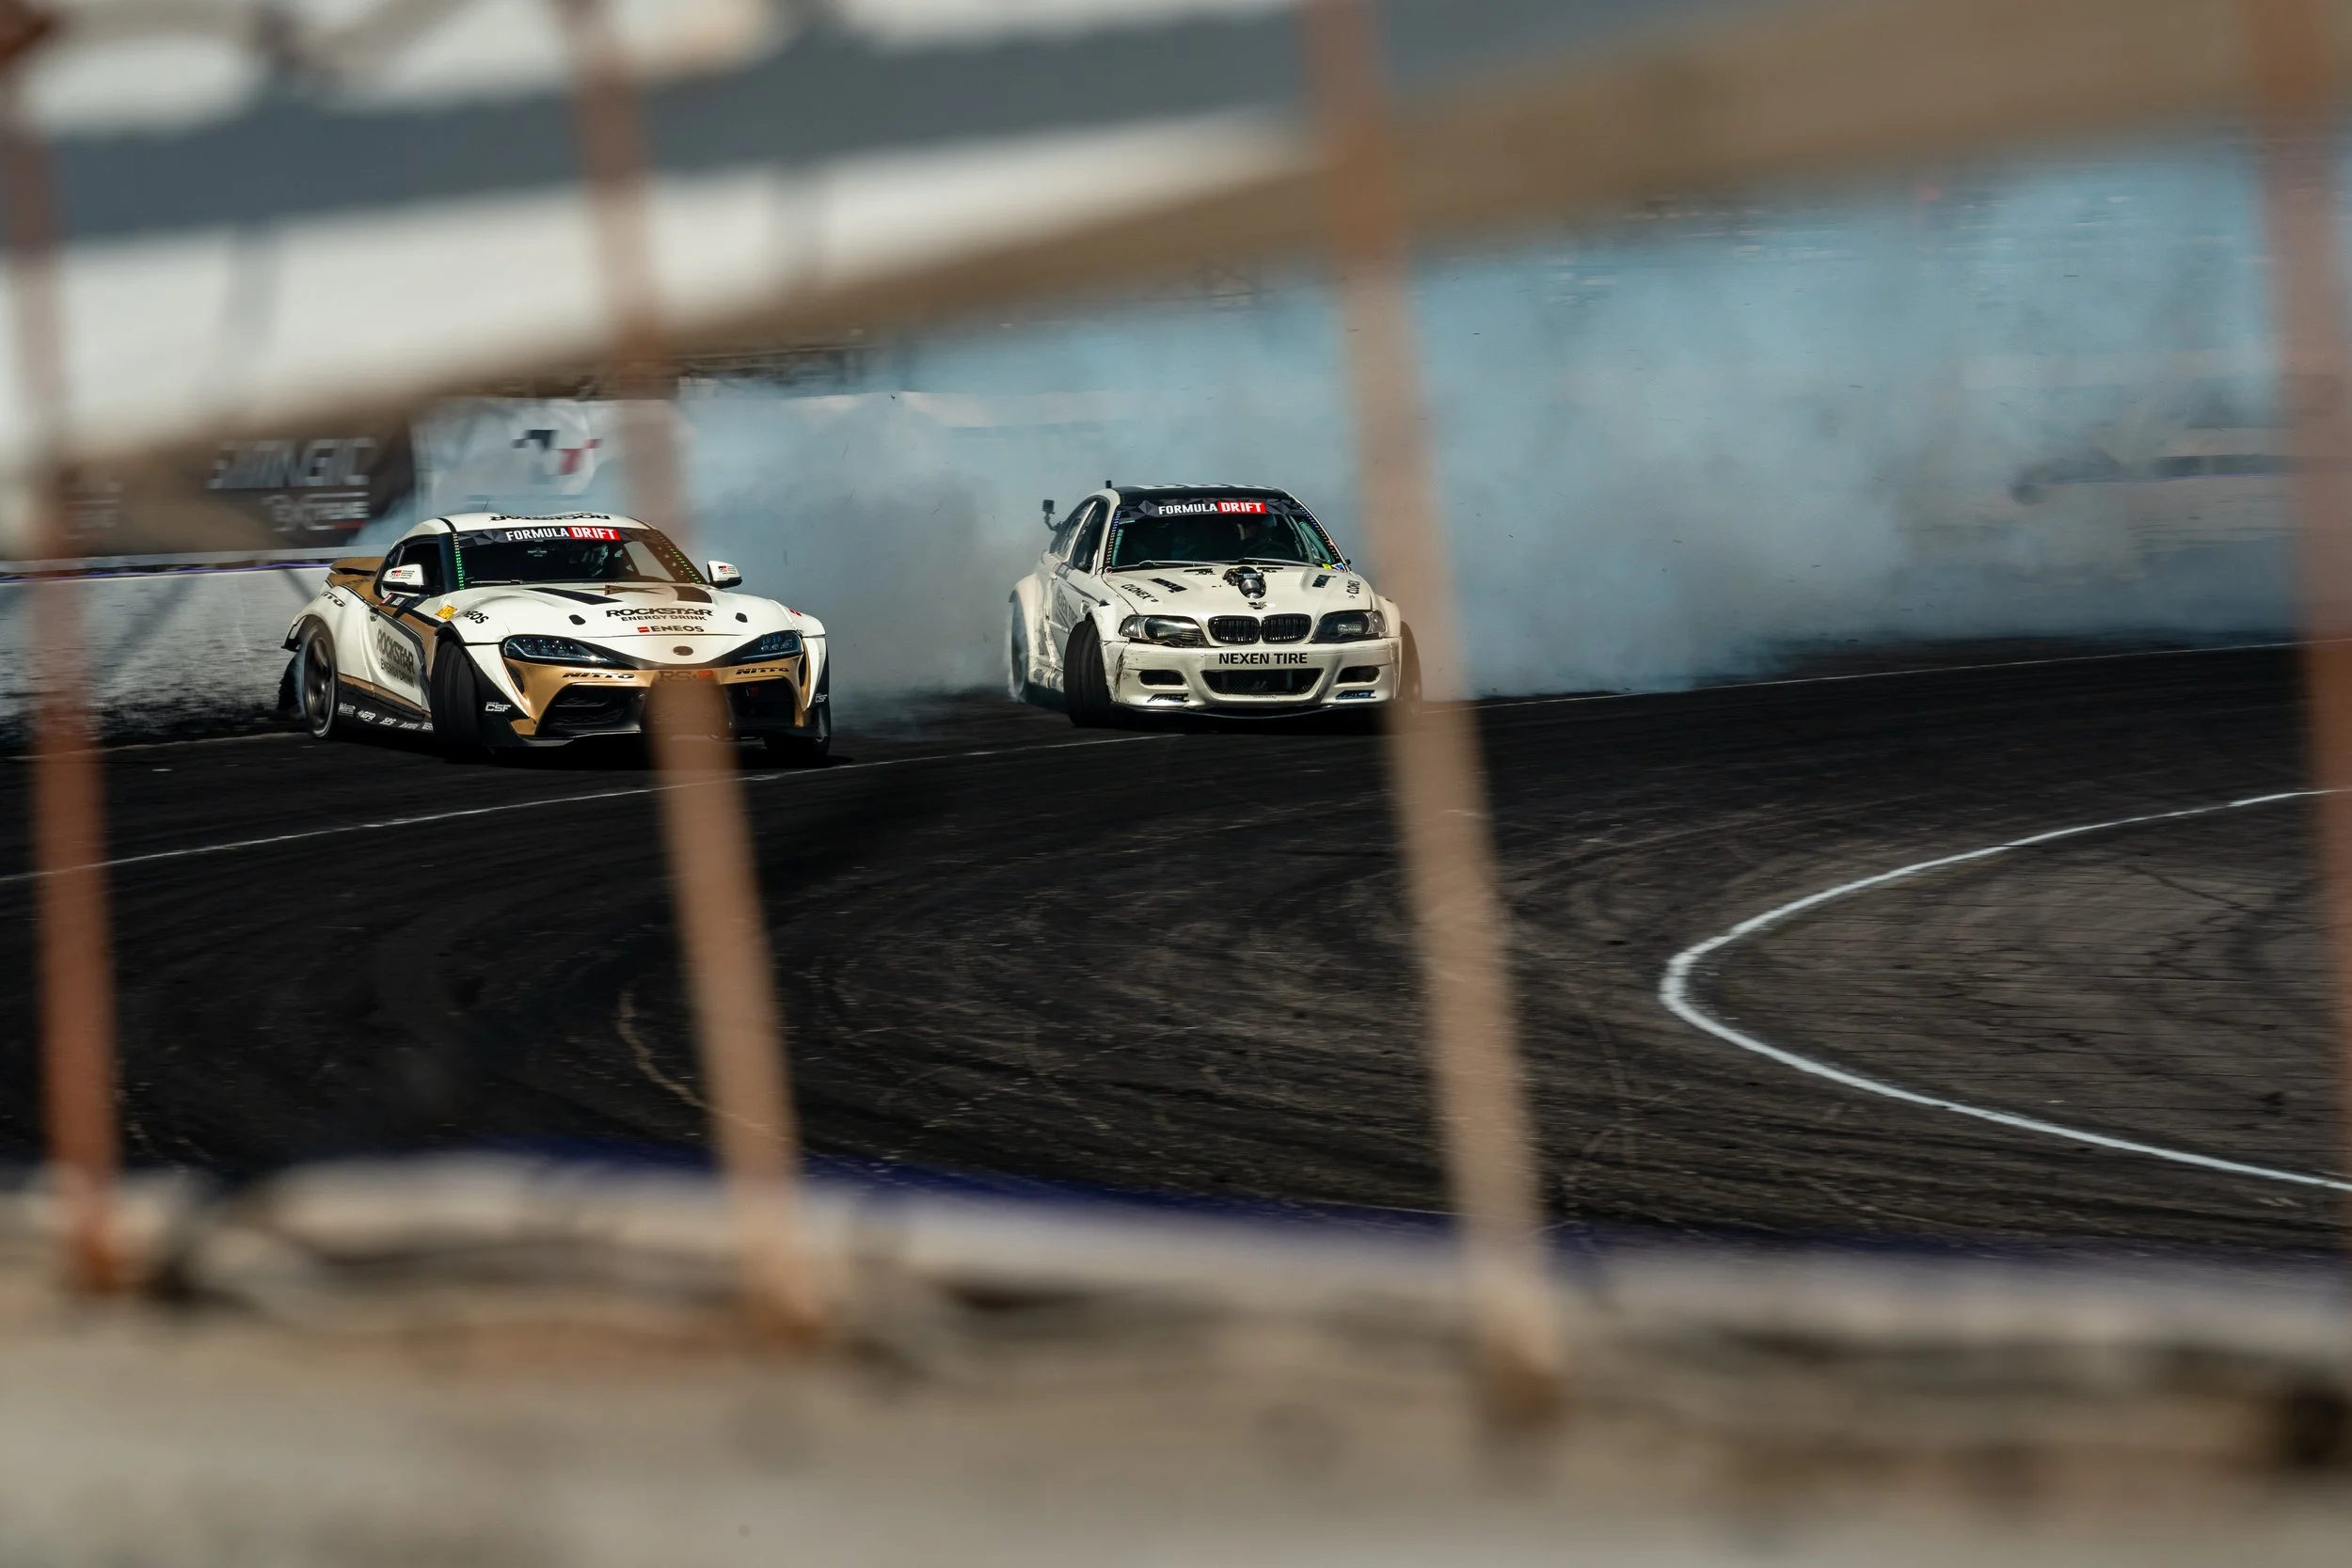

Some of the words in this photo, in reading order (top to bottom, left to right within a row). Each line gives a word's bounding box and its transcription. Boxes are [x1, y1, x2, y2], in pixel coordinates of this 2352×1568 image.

[1158, 503, 1218, 515] FORMULA
[1220, 501, 1263, 513] DRIFT
[505, 527, 570, 541] FORMULA
[570, 527, 615, 540] DRIFT
[606, 608, 714, 617] ROCKSTAR
[1218, 653, 1270, 664] NEXEN
[1274, 652, 1308, 664] TIRE
[736, 667, 789, 675] NITTO
[485, 704, 512, 712] CSF
